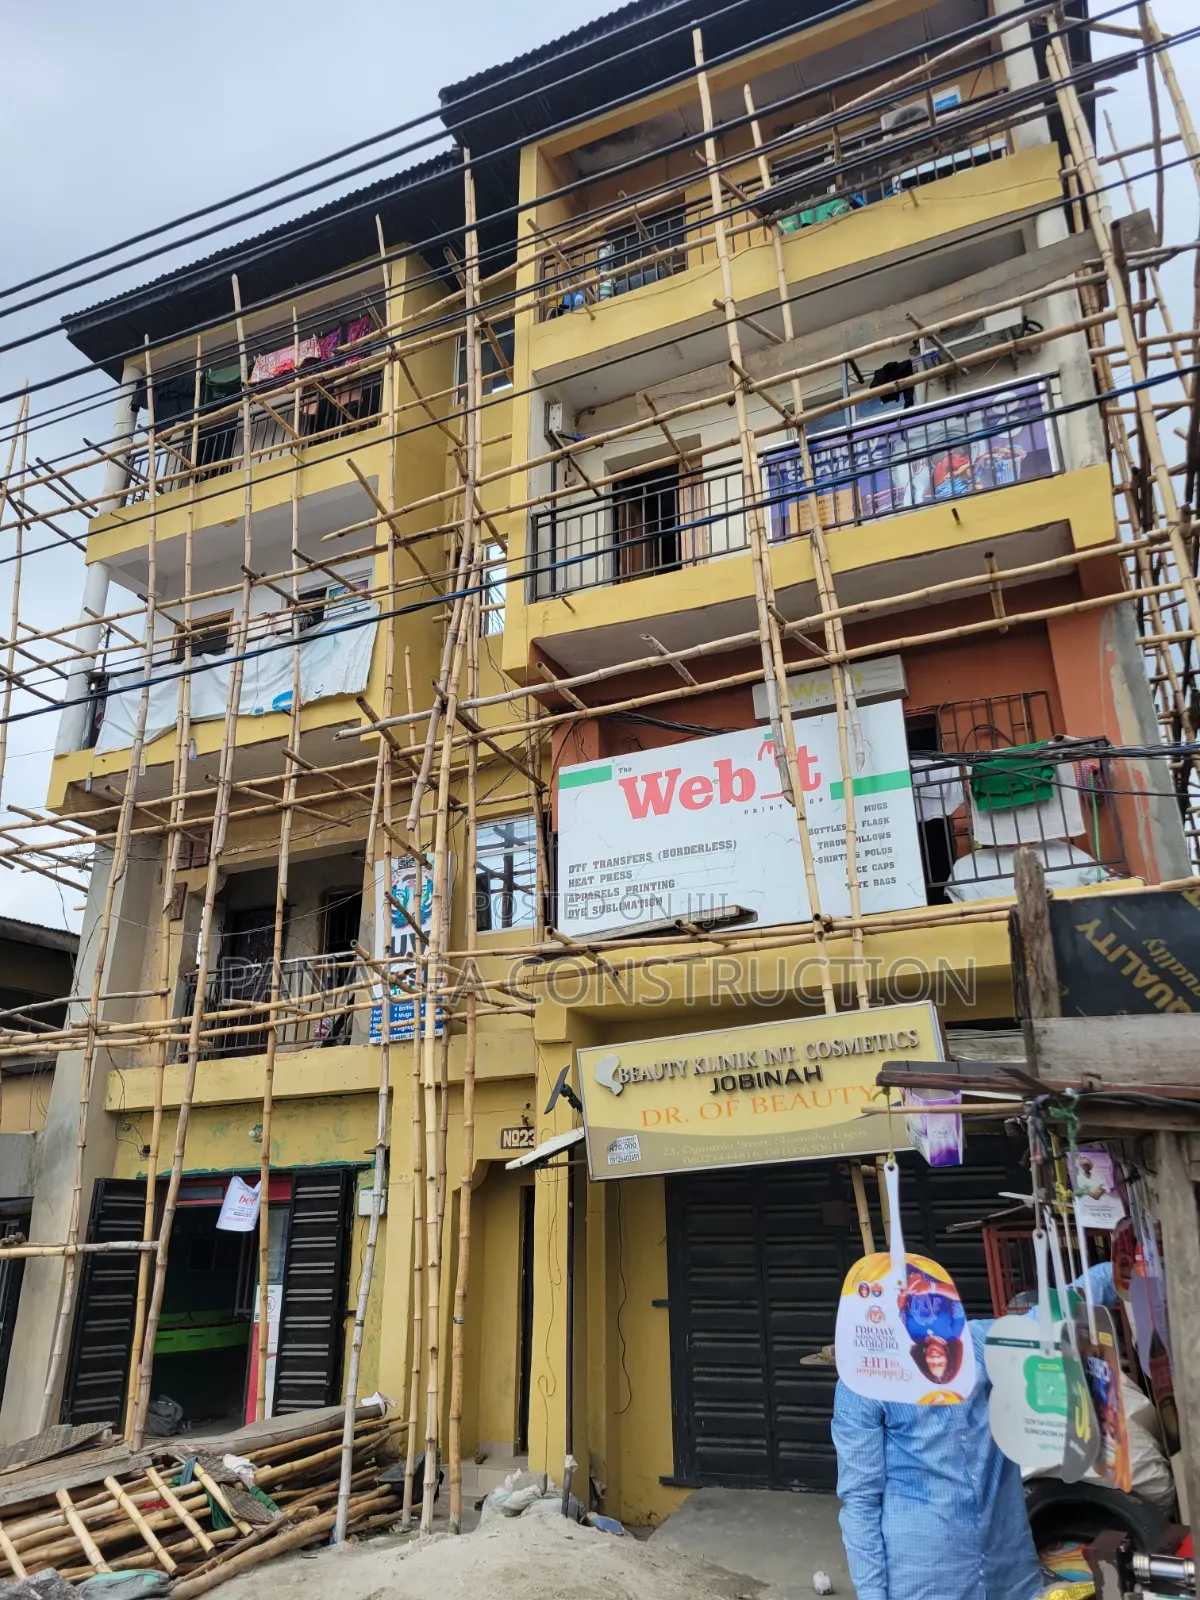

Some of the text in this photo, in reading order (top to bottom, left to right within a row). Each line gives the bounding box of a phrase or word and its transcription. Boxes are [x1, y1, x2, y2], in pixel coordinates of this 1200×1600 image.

[618, 766, 633, 774] The
[863, 802, 889, 813] MUGS
[808, 823, 847, 836] BOTTLES
[861, 816, 891, 828] FLASK
[817, 838, 848, 850] THROW
[864, 846, 893, 857] POLOS
[568, 839, 738, 875] DTF TRANSFERS (BORDERLESS)
[871, 861, 896, 872] CAPS
[568, 869, 633, 888] HEAT PRESS
[873, 876, 897, 887] BAGS
[568, 878, 676, 904] APPARELS PRINTING
[568, 896, 664, 919] DYE SUBLIMATION
[618, 1029, 920, 1085] BEAUTY KLINIK INT. COSMETICS
[710, 1064, 823, 1095] JOBINAH
[641, 1084, 877, 1128] DR. OF BEAUTY
[682, 1140, 734, 1156] Oguntolu
